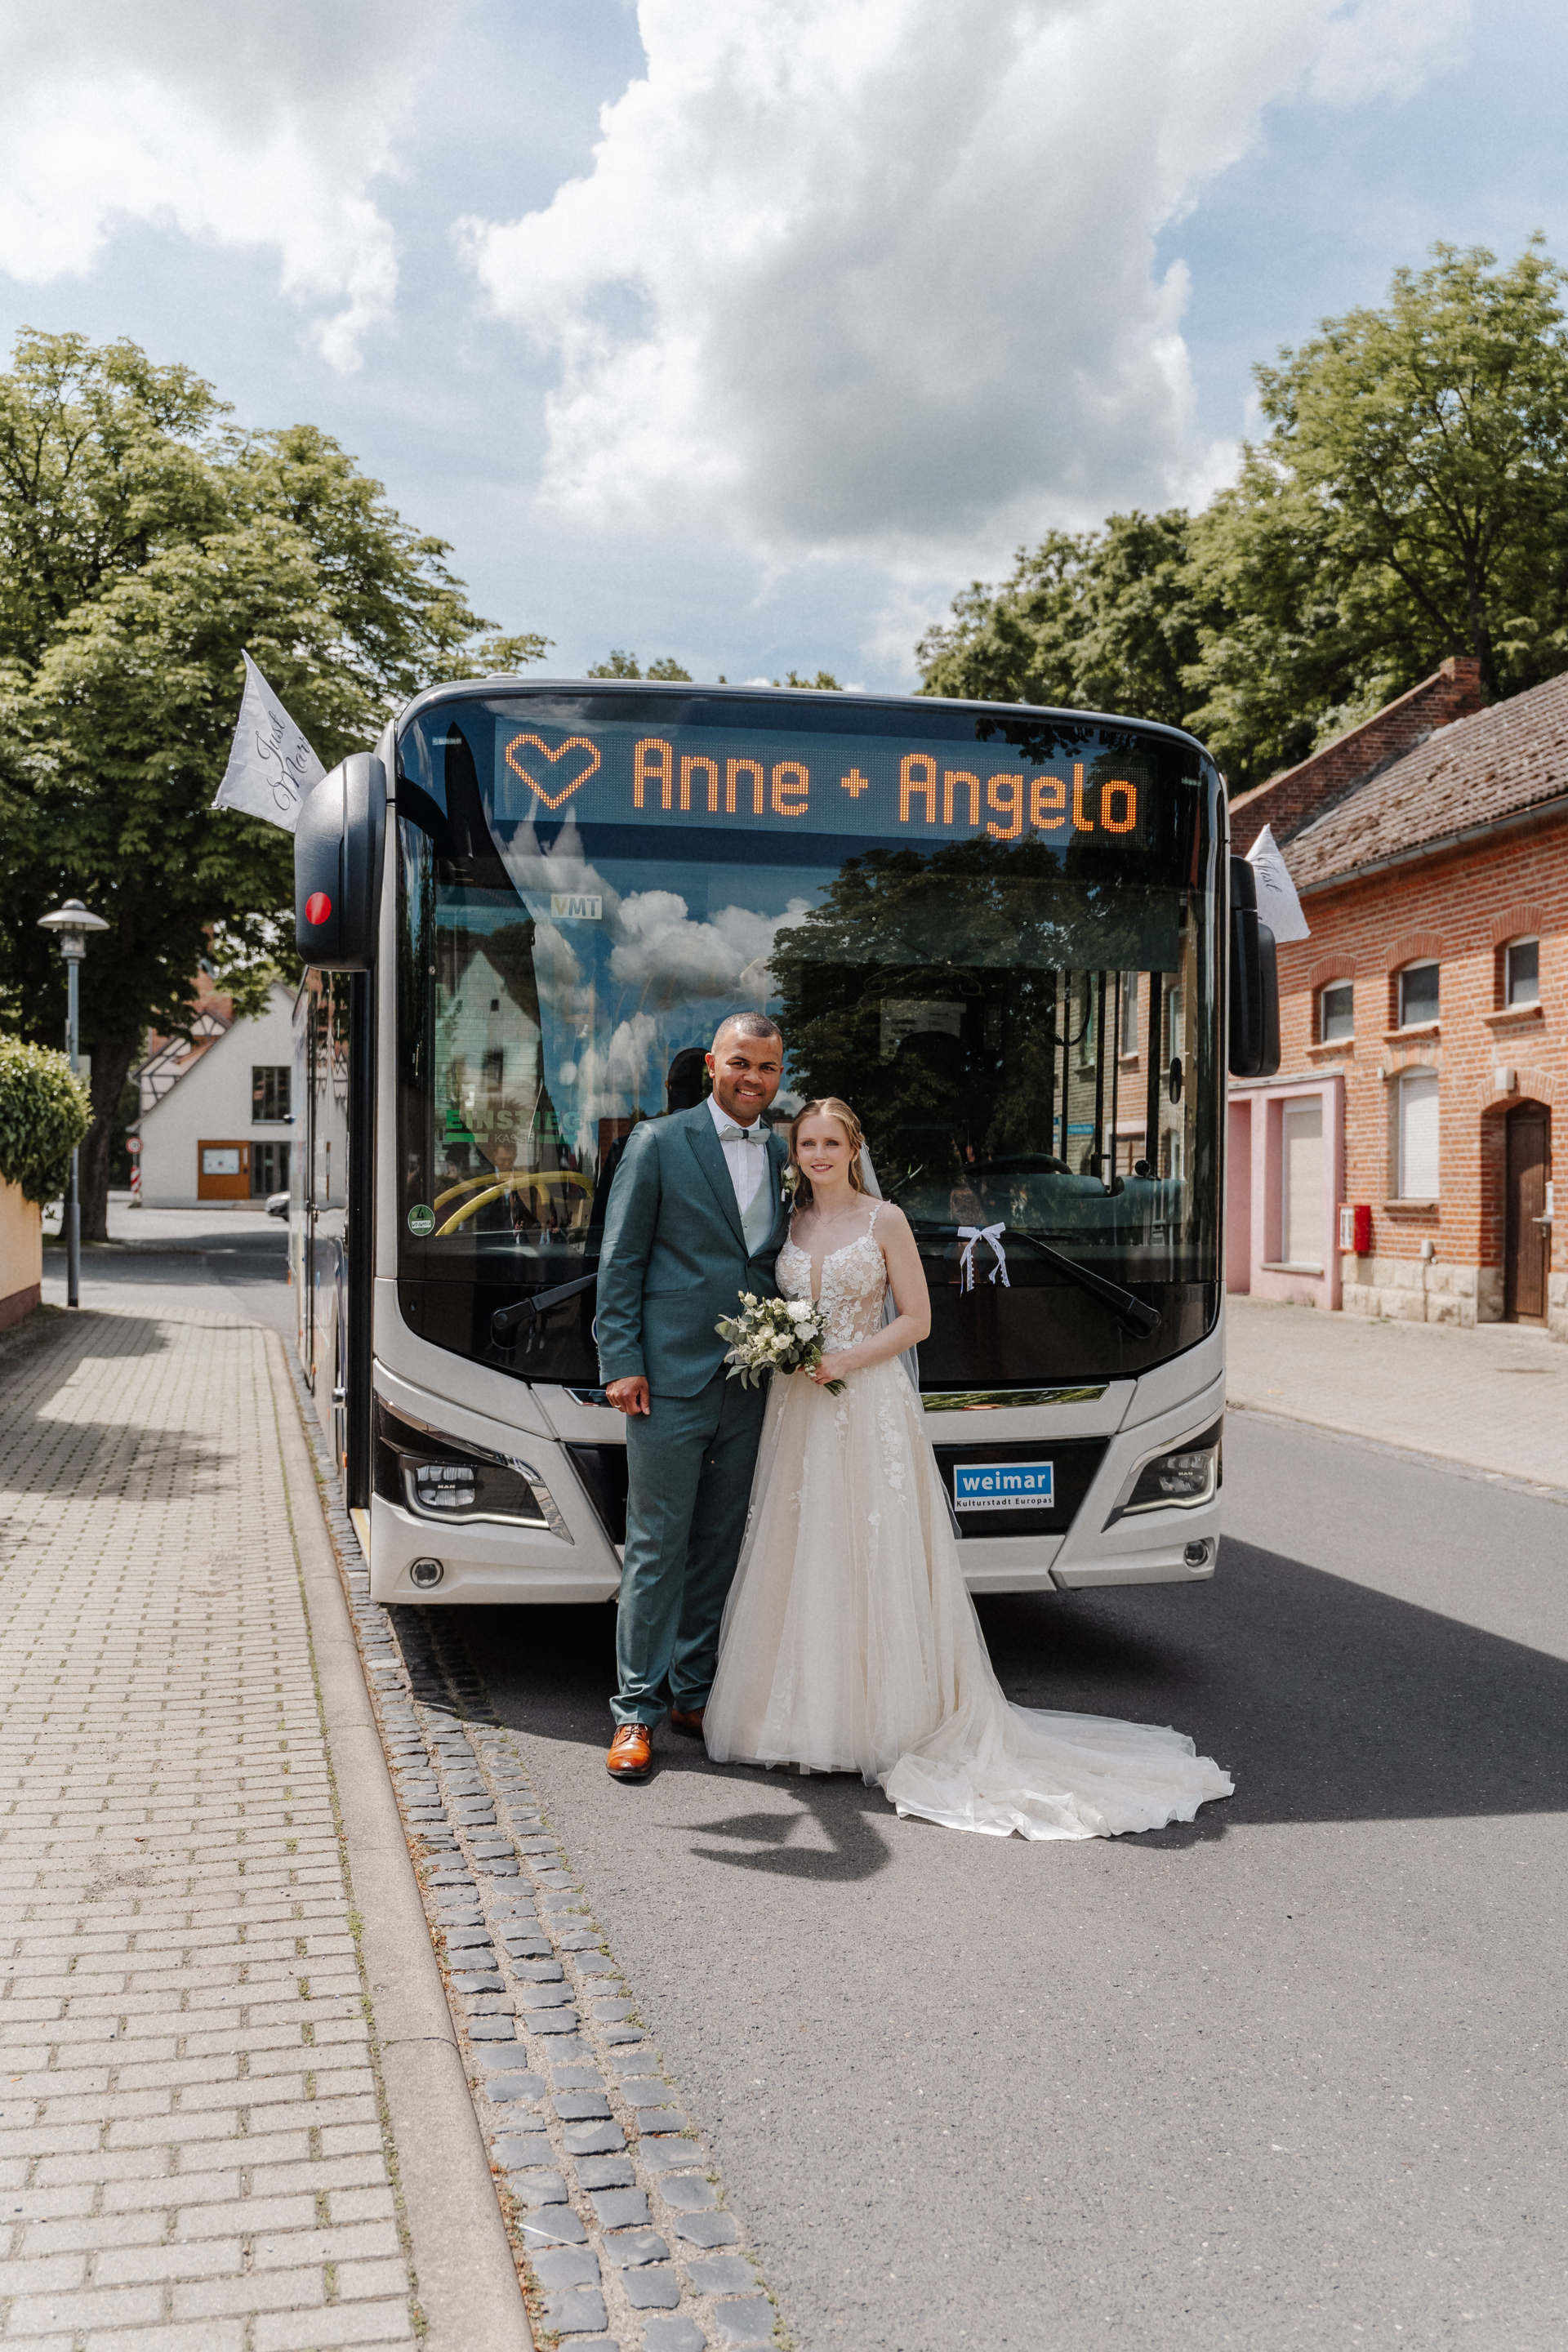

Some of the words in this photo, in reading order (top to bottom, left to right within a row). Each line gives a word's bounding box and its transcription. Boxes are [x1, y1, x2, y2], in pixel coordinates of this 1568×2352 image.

[256, 710, 285, 772] Just
[634, 738, 809, 816] Anne
[841, 768, 868, 798] +
[899, 753, 1137, 840] Angelo
[1253, 857, 1283, 893] Just
[553, 897, 599, 917] VMT
[446, 1109, 581, 1131] EINSTIEG
[494, 1134, 534, 1144] KASSE
[417, 1207, 425, 1220] 4
[962, 1471, 1046, 1491] weimar
[956, 1498, 1011, 1508] Kulturstadt
[1015, 1497, 1052, 1505] Europas
